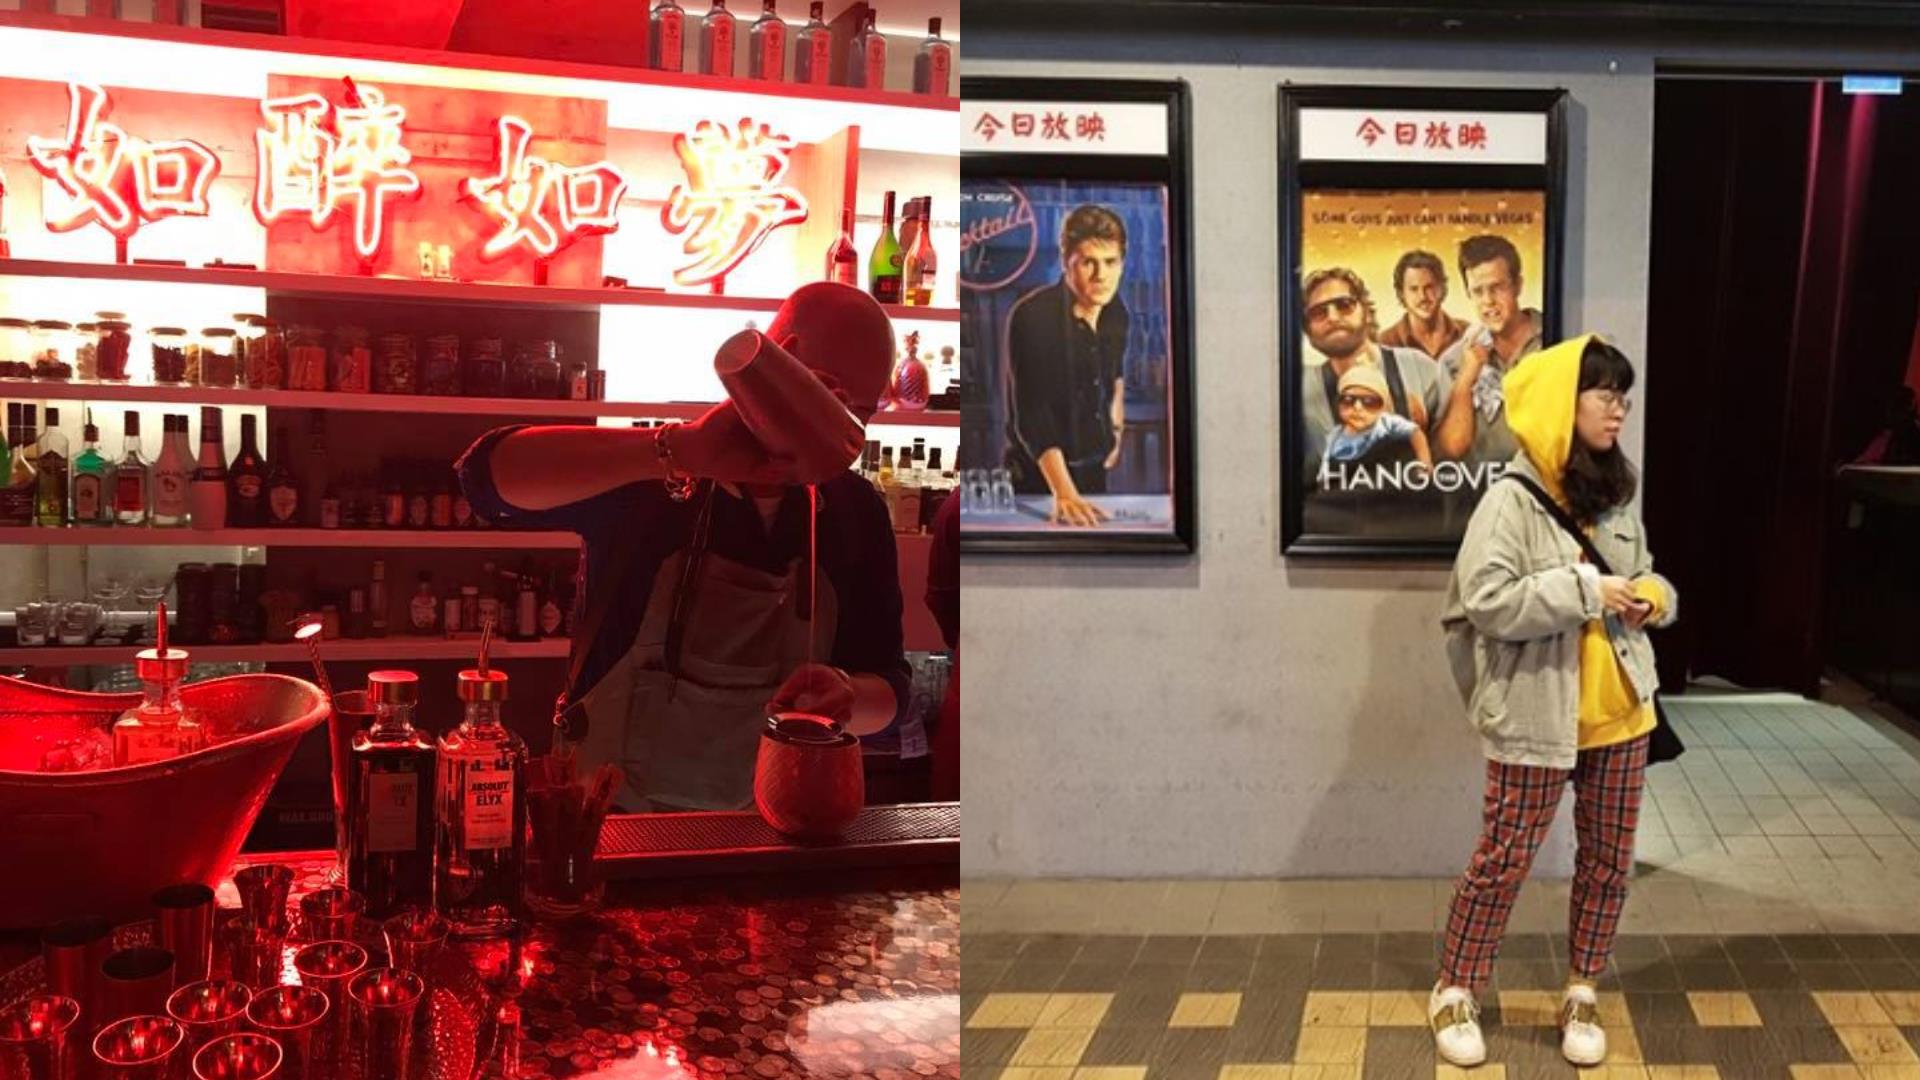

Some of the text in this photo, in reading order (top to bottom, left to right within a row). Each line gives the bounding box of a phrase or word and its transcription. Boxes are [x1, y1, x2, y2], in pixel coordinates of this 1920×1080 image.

[974, 111, 1107, 142] 今日放映
[1355, 116, 1489, 150] 今日放映
[1322, 460, 1511, 492] HANGOVE
[471, 781, 509, 792] ABSOLUT
[476, 794, 502, 806] ELYX
